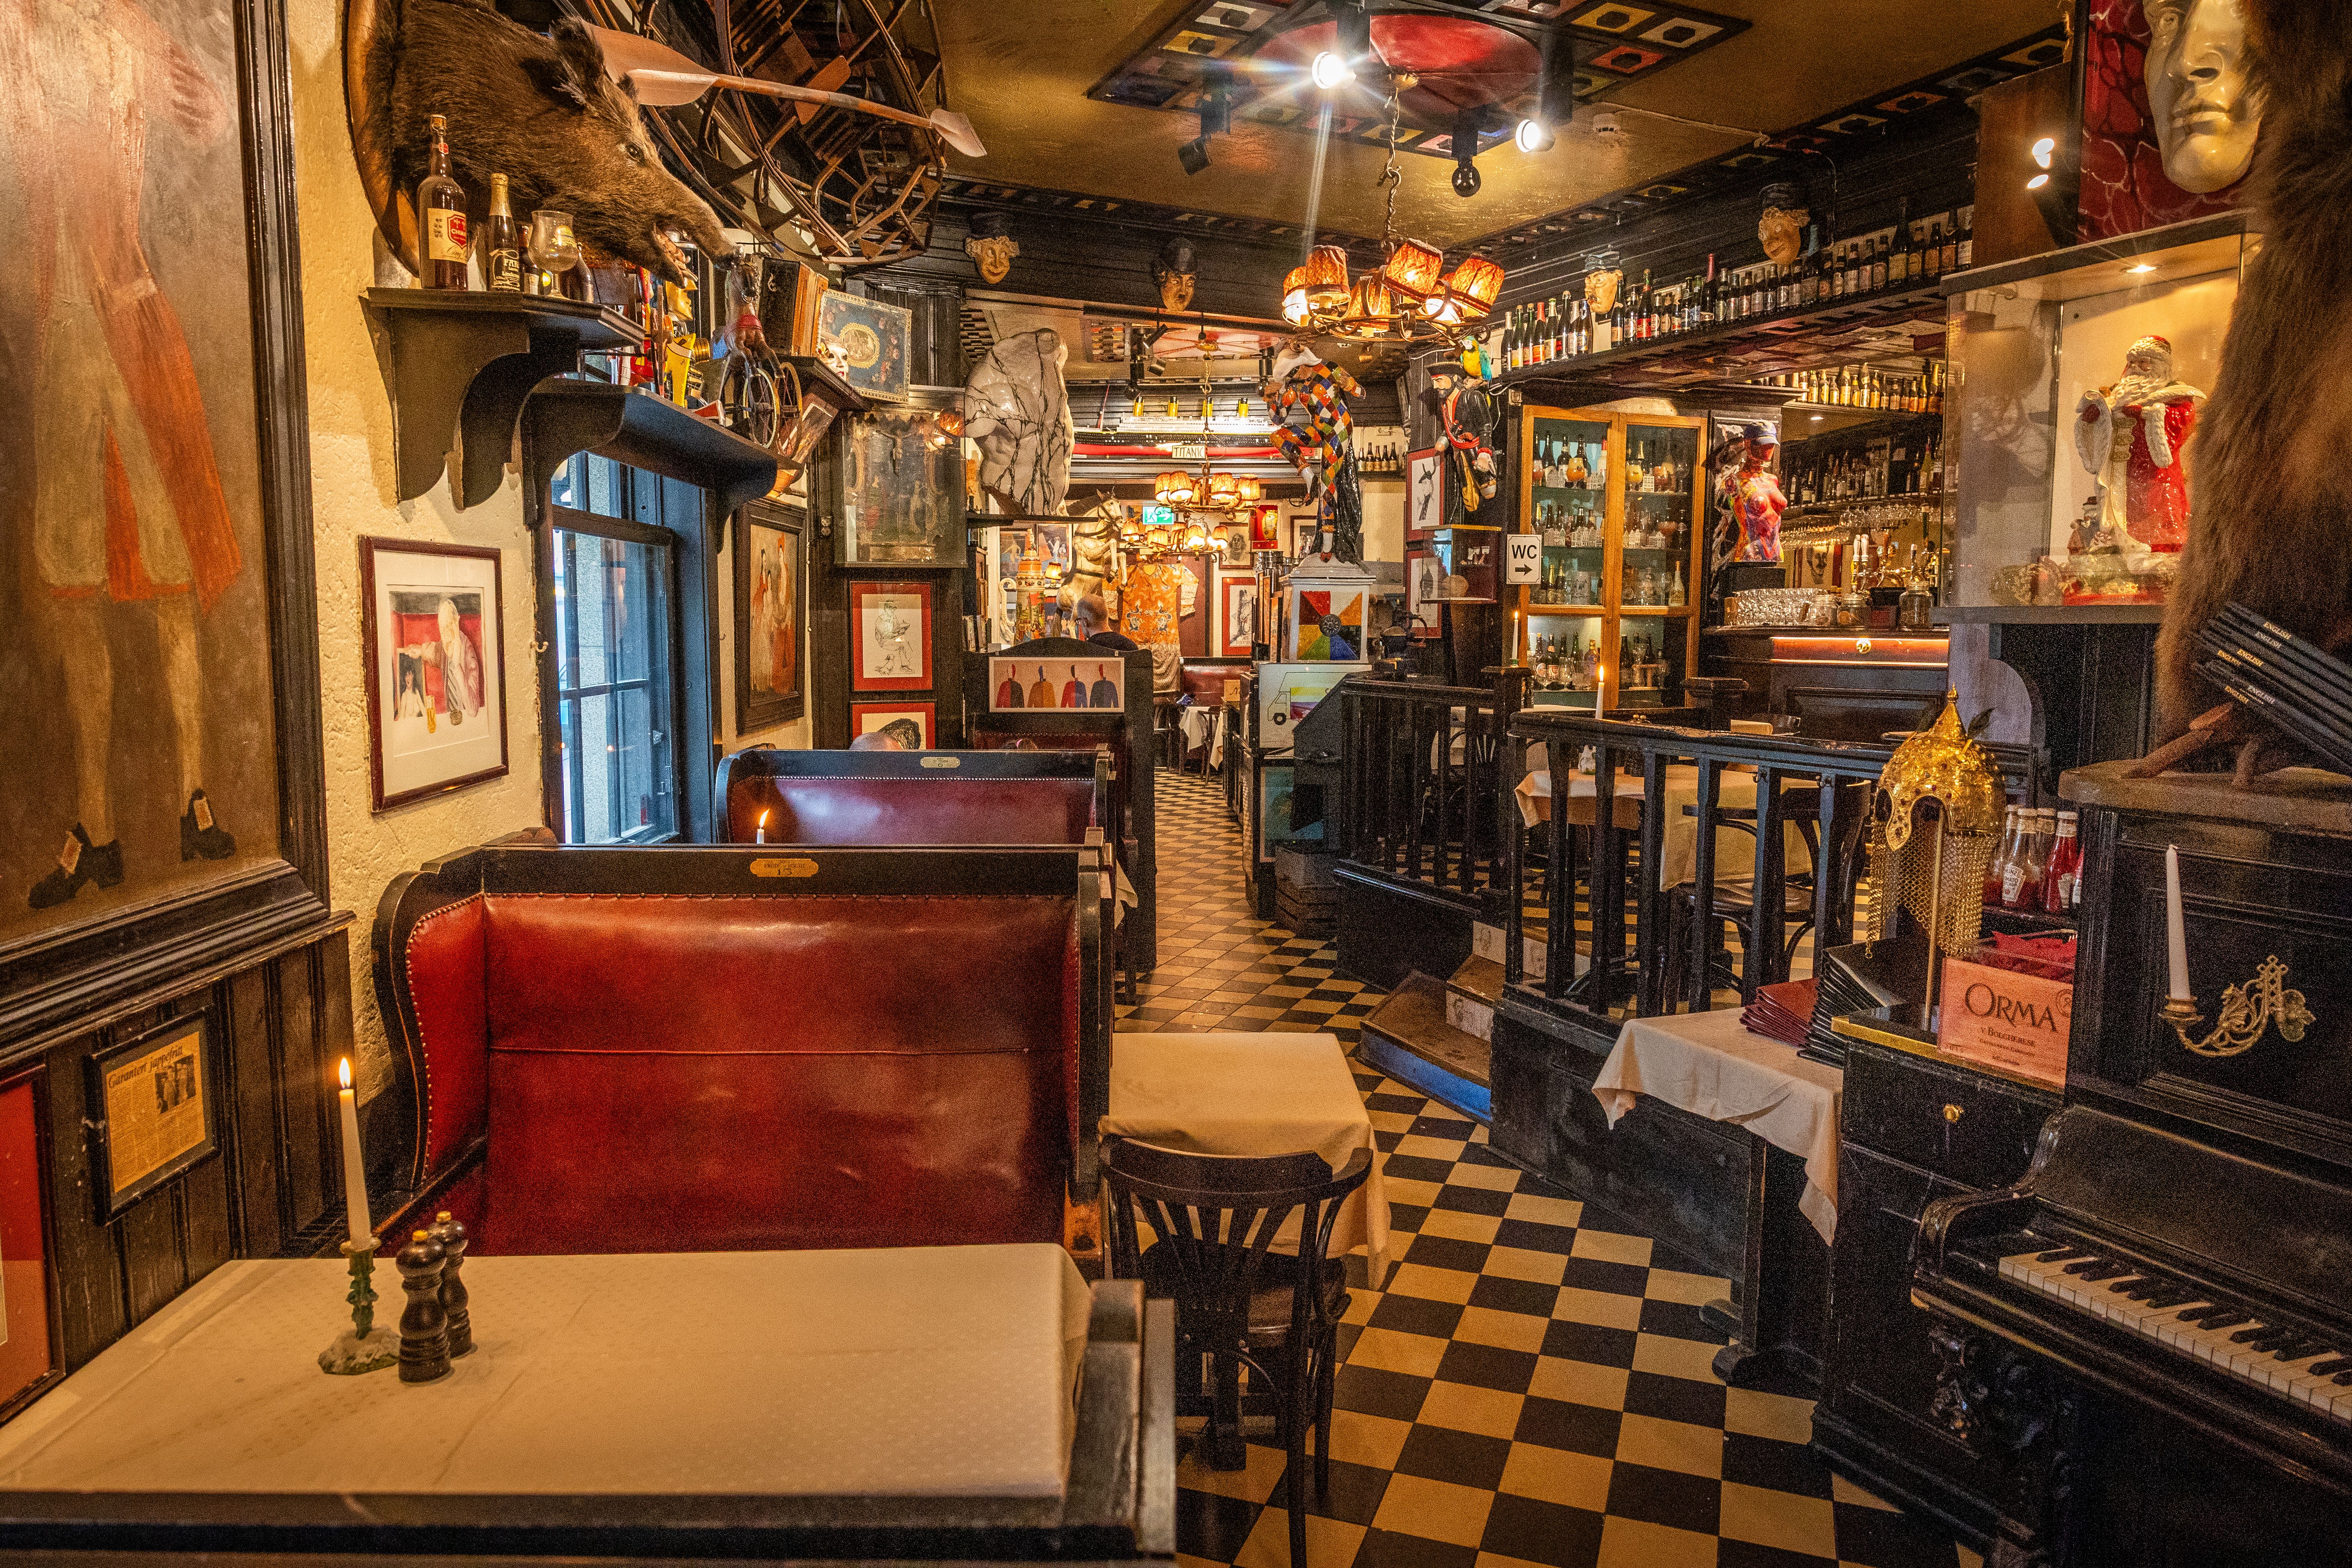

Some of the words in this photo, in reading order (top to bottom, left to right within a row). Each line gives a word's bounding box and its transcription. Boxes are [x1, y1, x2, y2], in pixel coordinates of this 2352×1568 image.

[451, 229, 466, 237] CHIM
[504, 259, 519, 269] FAR
[1174, 447, 1204, 458] TITANIC
[1512, 544, 1537, 559] WC
[2263, 621, 2292, 640] ENGLISH
[2255, 632, 2282, 649] ENGLISH
[2237, 648, 2264, 667] ENGLISH
[2225, 685, 2249, 704] ENGLISH
[2248, 685, 2275, 704] ENGLISH
[1965, 983, 2057, 1033] ORMA
